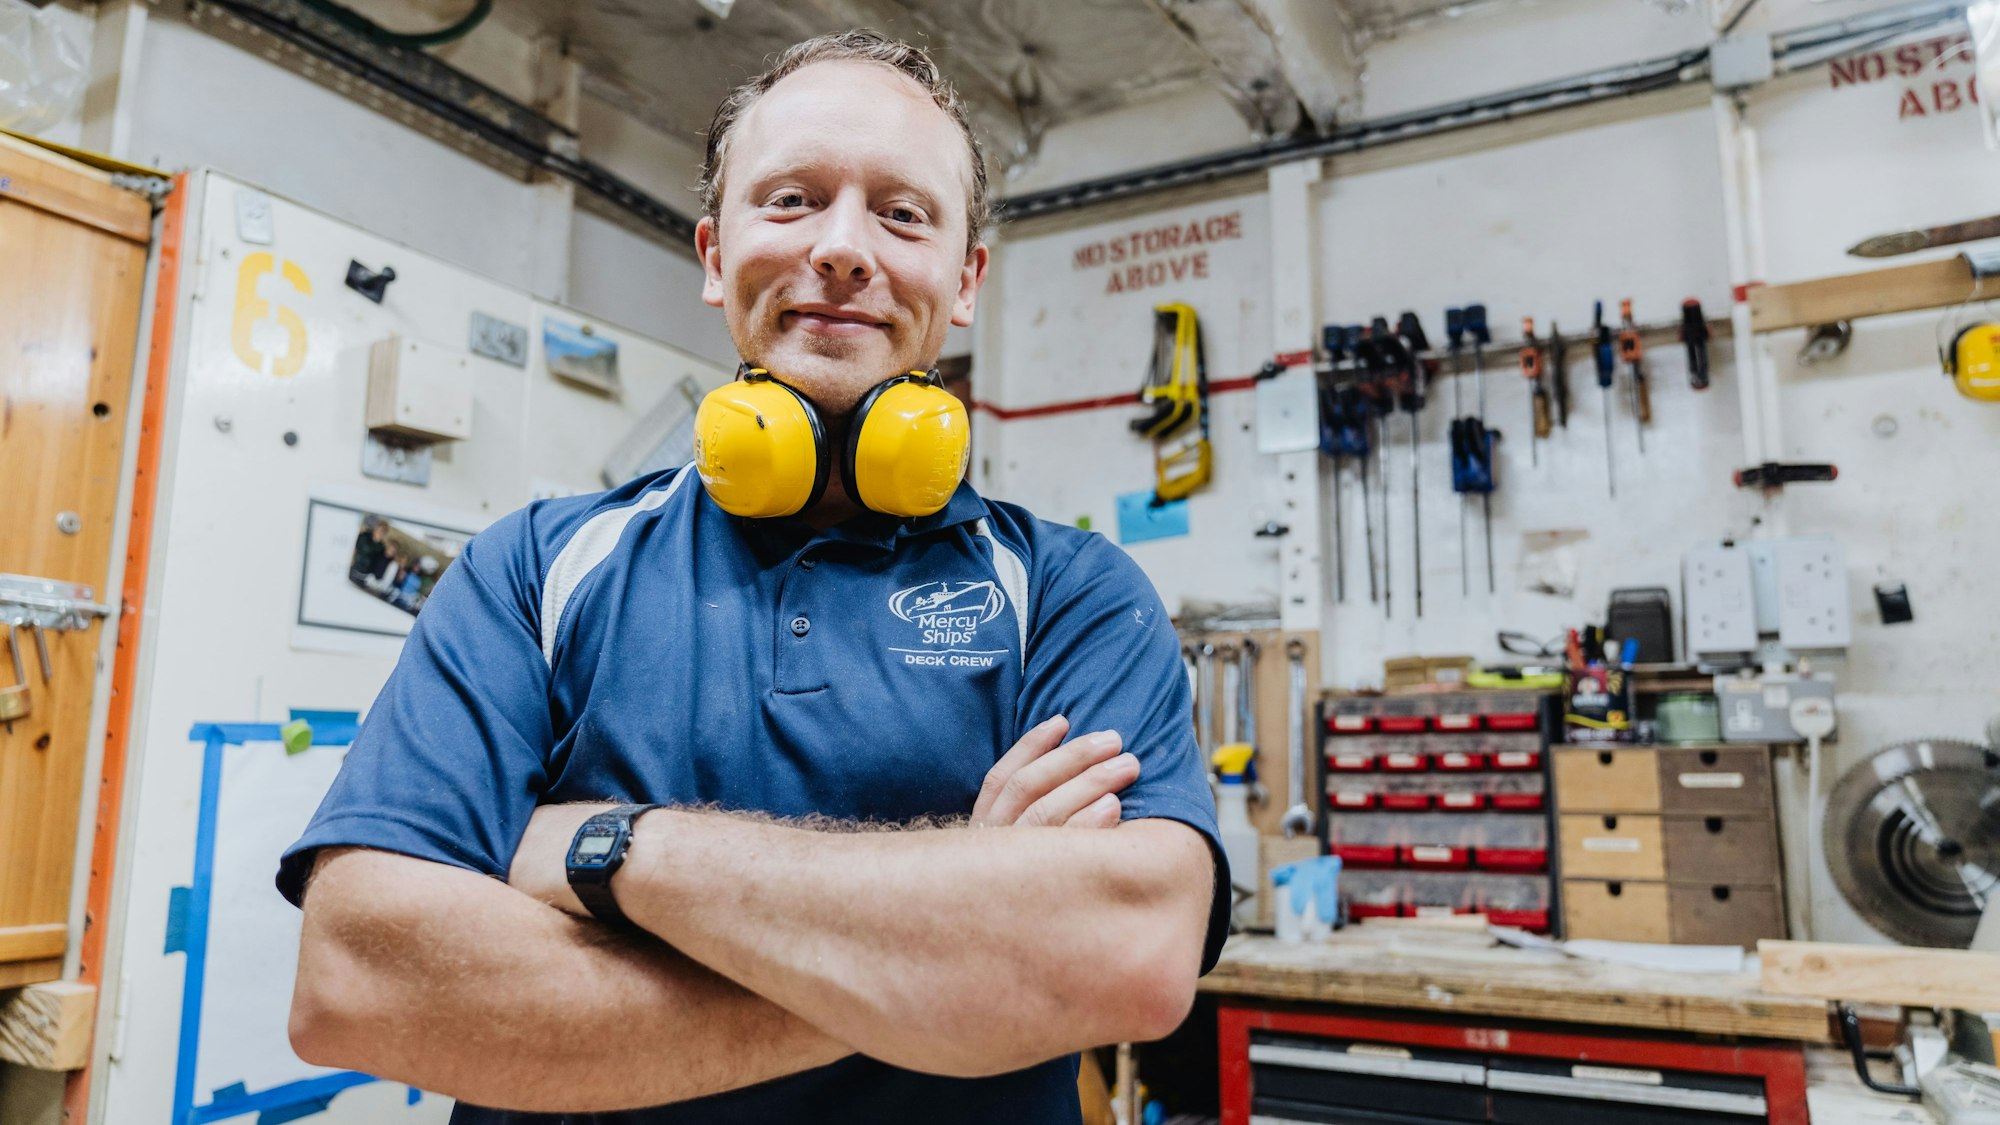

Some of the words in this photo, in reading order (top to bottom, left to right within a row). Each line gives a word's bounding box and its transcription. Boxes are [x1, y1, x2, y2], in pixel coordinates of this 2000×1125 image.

[1829, 52, 1886, 88] NO
[1073, 240, 1106, 270] NO
[1109, 212, 1243, 263] STORAGE
[1107, 251, 1209, 294] ABOVE
[231, 252, 313, 378] 6
[918, 614, 977, 631] Mercy
[905, 654, 946, 666] DECK
[949, 655, 994, 667] CREW
